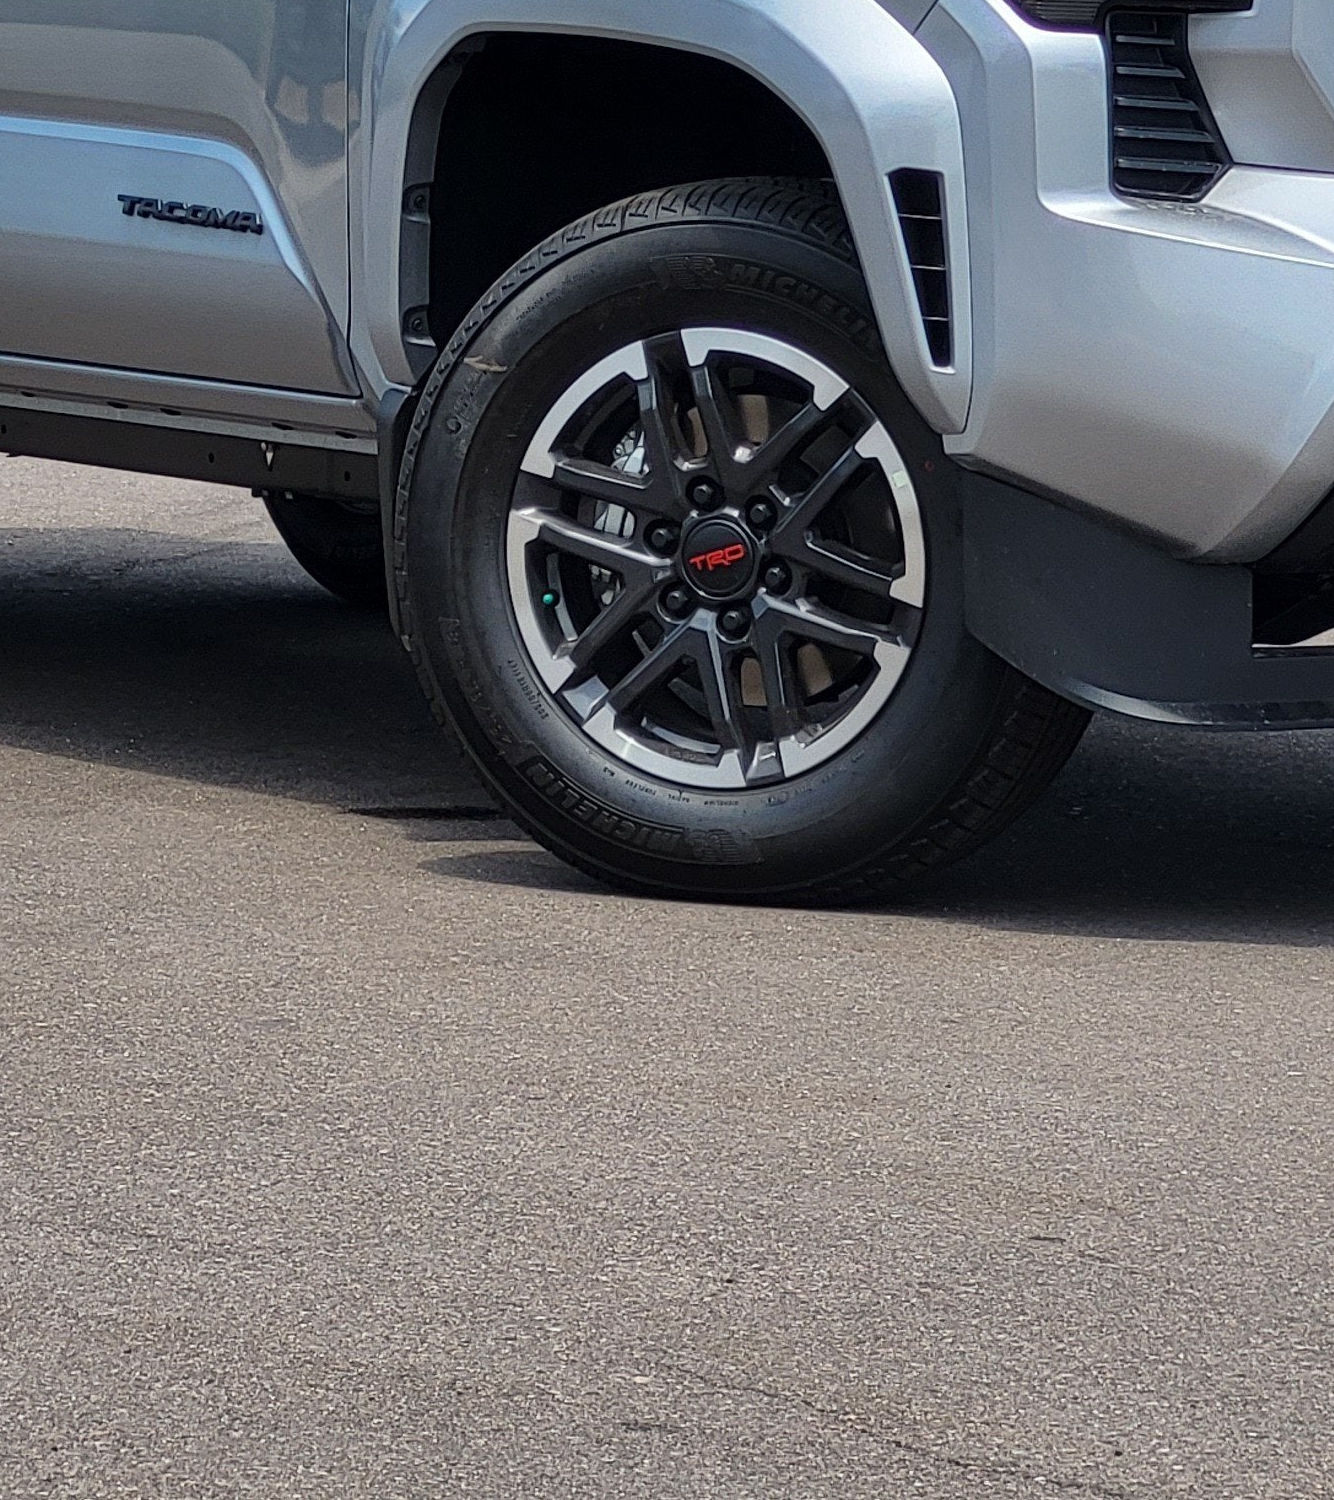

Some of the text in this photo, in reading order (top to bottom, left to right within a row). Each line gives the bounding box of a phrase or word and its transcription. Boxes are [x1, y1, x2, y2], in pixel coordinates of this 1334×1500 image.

[117, 193, 264, 236] TACOMA
[689, 543, 745, 572] TRD
[524, 761, 683, 850] MICHELIN
